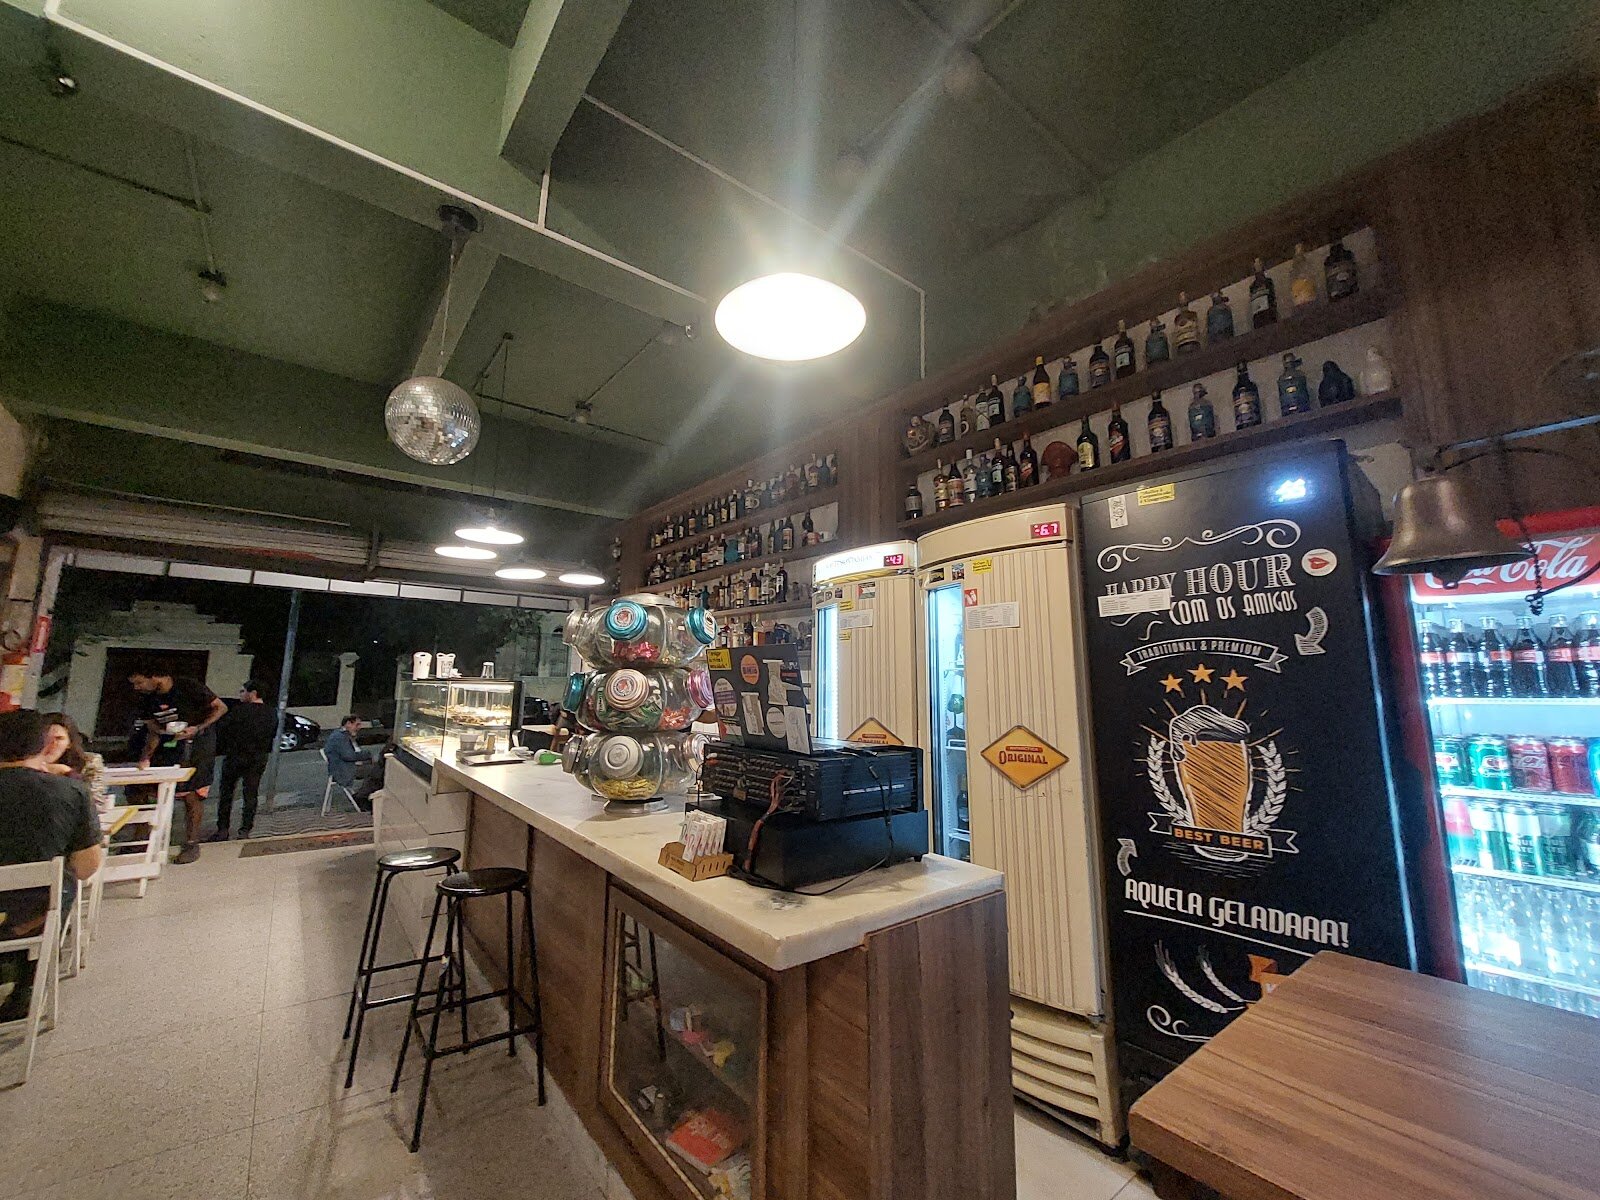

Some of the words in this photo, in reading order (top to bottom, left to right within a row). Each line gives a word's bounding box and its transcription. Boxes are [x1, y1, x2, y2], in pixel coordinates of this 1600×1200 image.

[1105, 572, 1177, 598] HAPPY
[1184, 553, 1296, 596] HOUR
[1169, 598, 1209, 625] COM
[1216, 596, 1236, 620] OS
[1242, 590, 1298, 616] AMIGOS
[1137, 641, 1197, 660] TRADITIONAL
[1200, 641, 1208, 651] &
[1211, 640, 1262, 656] PREMIUM
[1174, 828, 1212, 843] BEST
[1219, 834, 1265, 850] BEER
[1125, 878, 1203, 918] AQUELA
[1208, 897, 1349, 948] GELADAAA!
